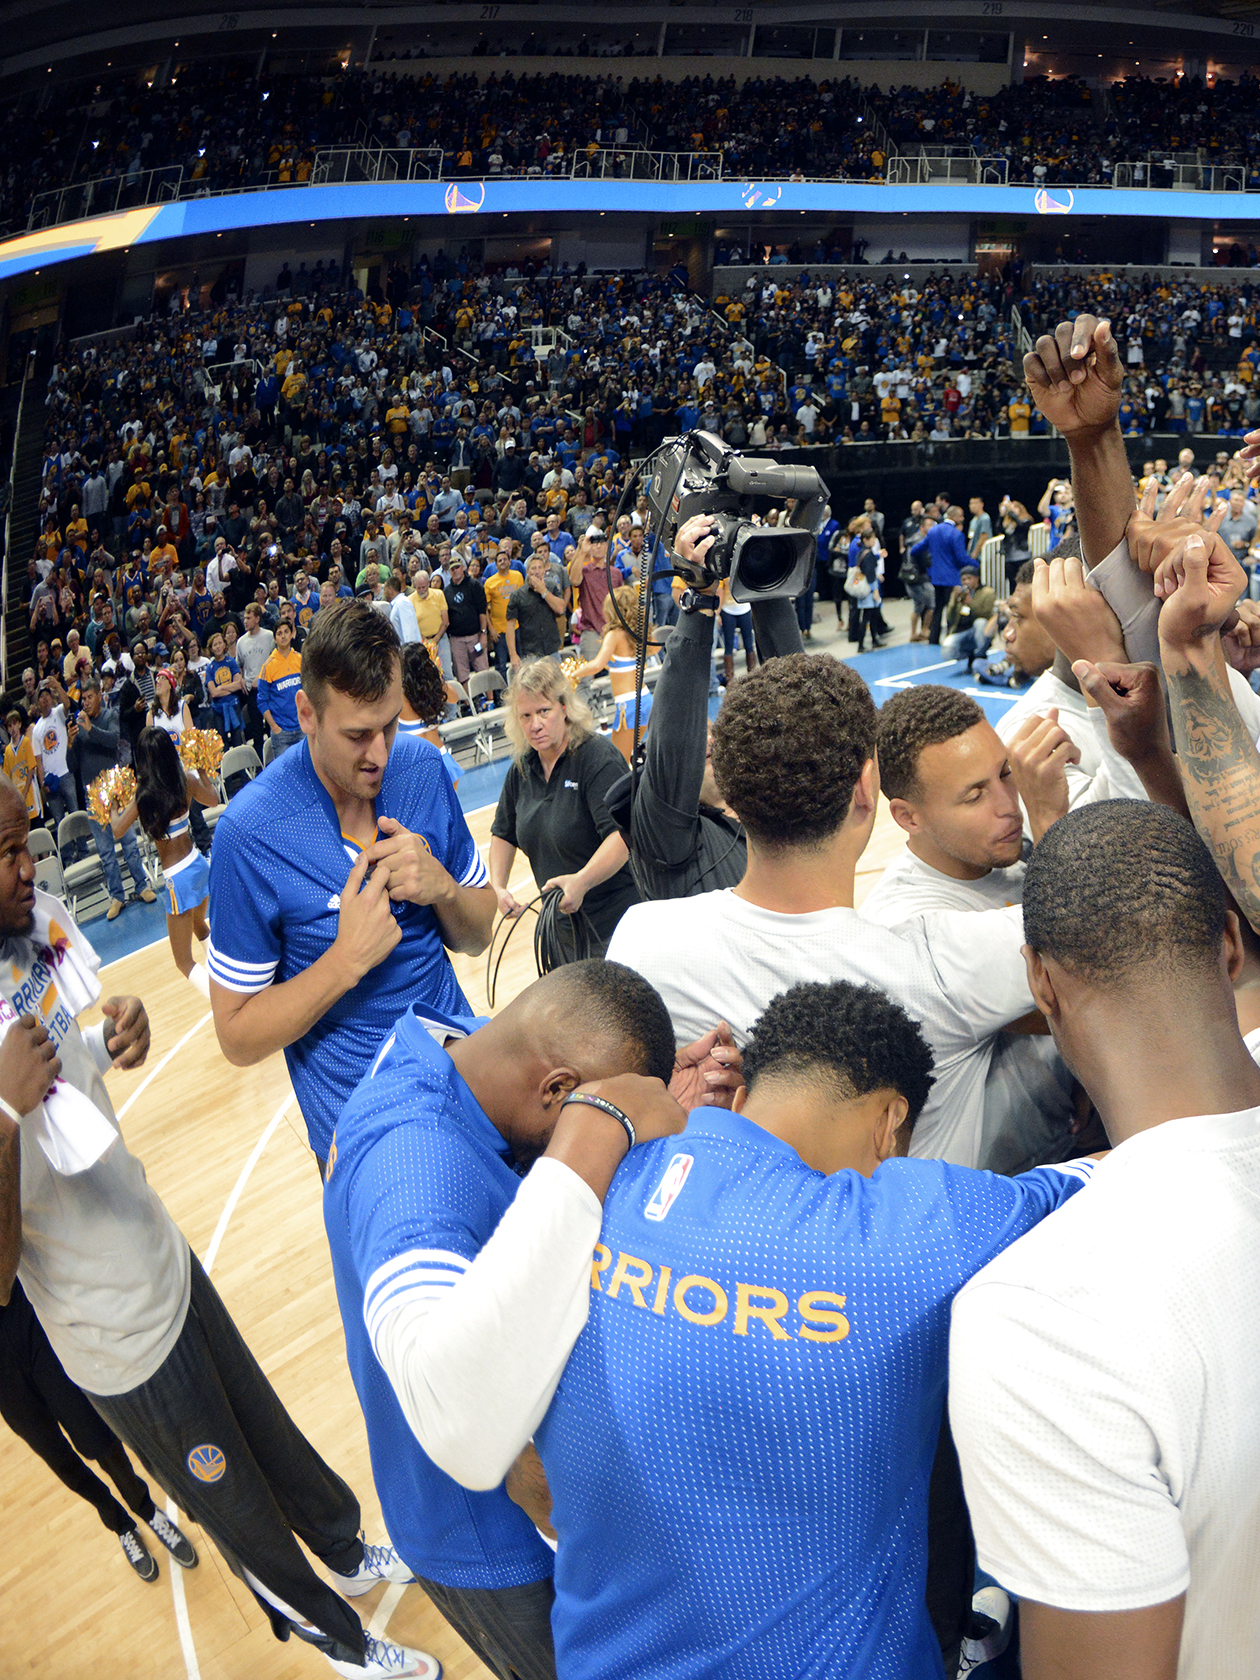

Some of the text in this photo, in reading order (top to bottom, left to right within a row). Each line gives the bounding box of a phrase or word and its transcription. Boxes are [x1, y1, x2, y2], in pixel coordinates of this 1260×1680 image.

[480, 6, 500, 19] 217
[734, 9, 753, 22] 218
[982, 3, 1003, 15] 219
[1232, 22, 1254, 36] 220
